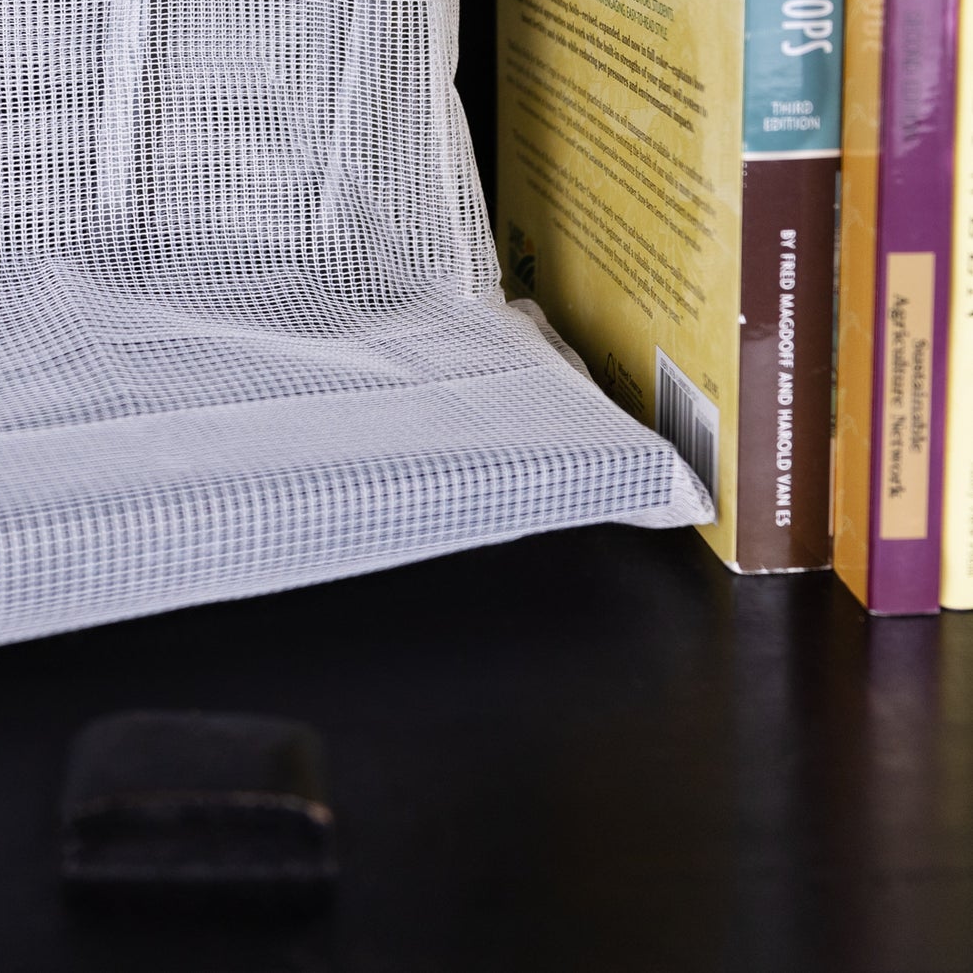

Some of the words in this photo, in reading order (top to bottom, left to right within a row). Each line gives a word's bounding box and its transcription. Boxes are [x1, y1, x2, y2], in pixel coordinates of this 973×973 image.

[770, 100, 814, 115] THIRD
[763, 116, 820, 132] EDITION
[779, 229, 796, 249] BY
[778, 252, 796, 291] FRED
[777, 293, 795, 368] MAGDOFF
[776, 372, 794, 405] AND
[776, 407, 794, 471] HAROLD
[775, 474, 792, 506] VAN
[775, 508, 791, 528] ES
